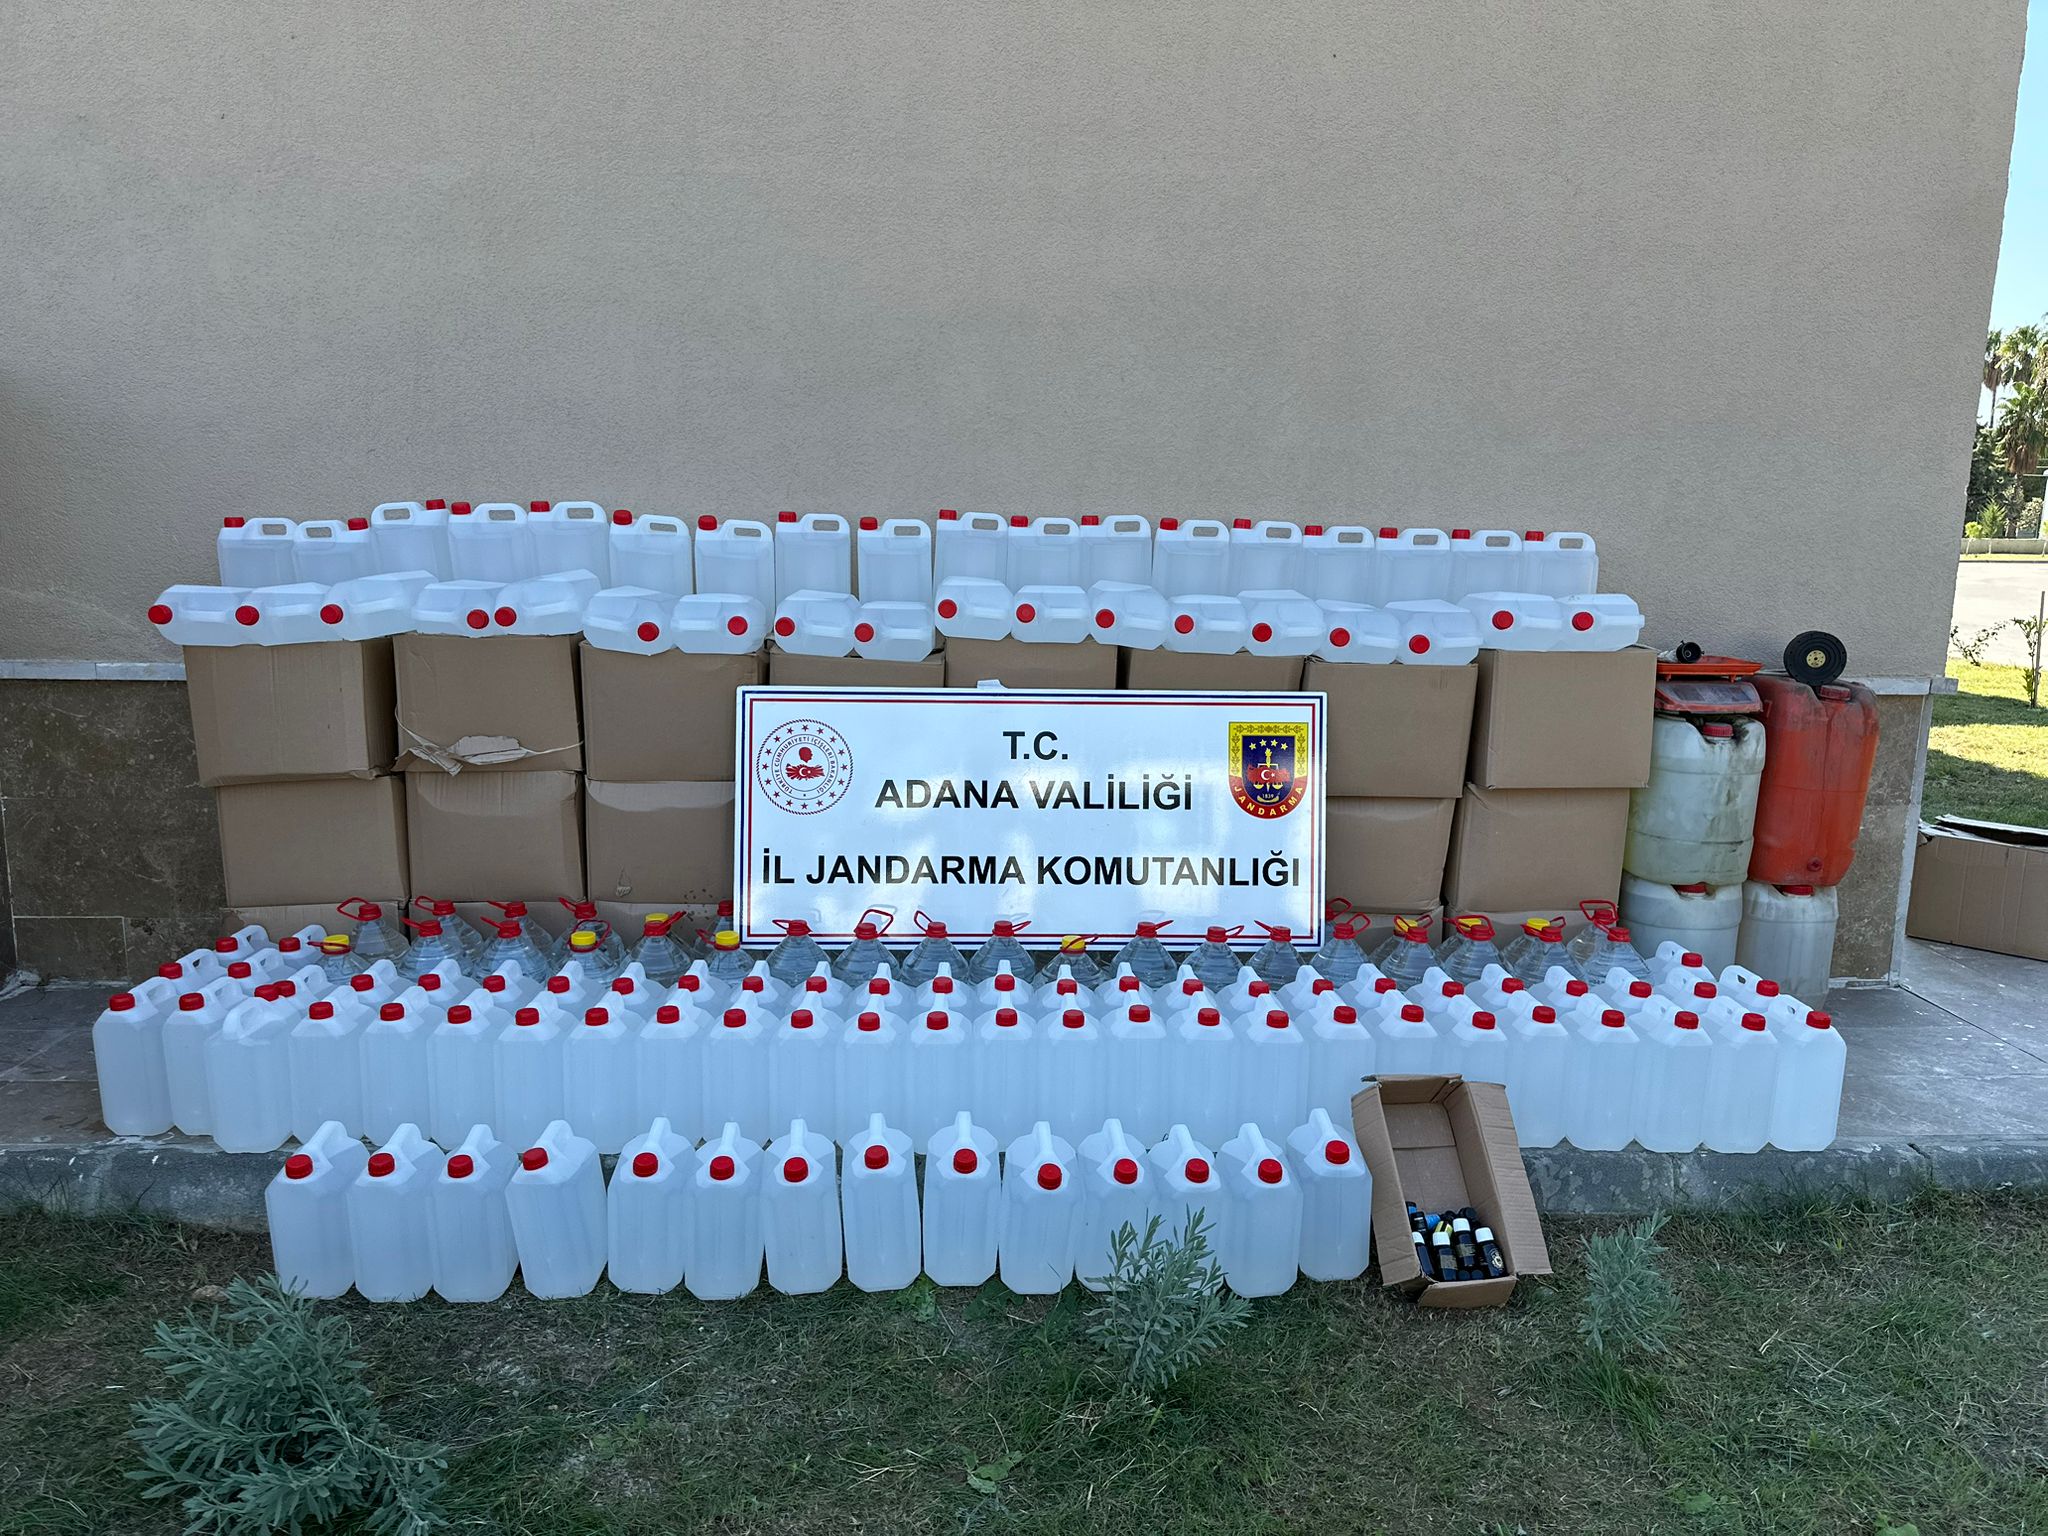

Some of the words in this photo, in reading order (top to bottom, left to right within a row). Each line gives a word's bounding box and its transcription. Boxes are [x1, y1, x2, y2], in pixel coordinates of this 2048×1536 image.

[1003, 729, 1069, 760] T.C.
[875, 779, 1020, 809] ADANA
[1028, 773, 1192, 811] VALİLİĞİ
[1234, 786, 1303, 816] JANDARMA
[762, 847, 796, 885] İL
[806, 854, 1027, 885] JANDARMA
[1037, 849, 1300, 887] KOMUTANLIĞI
